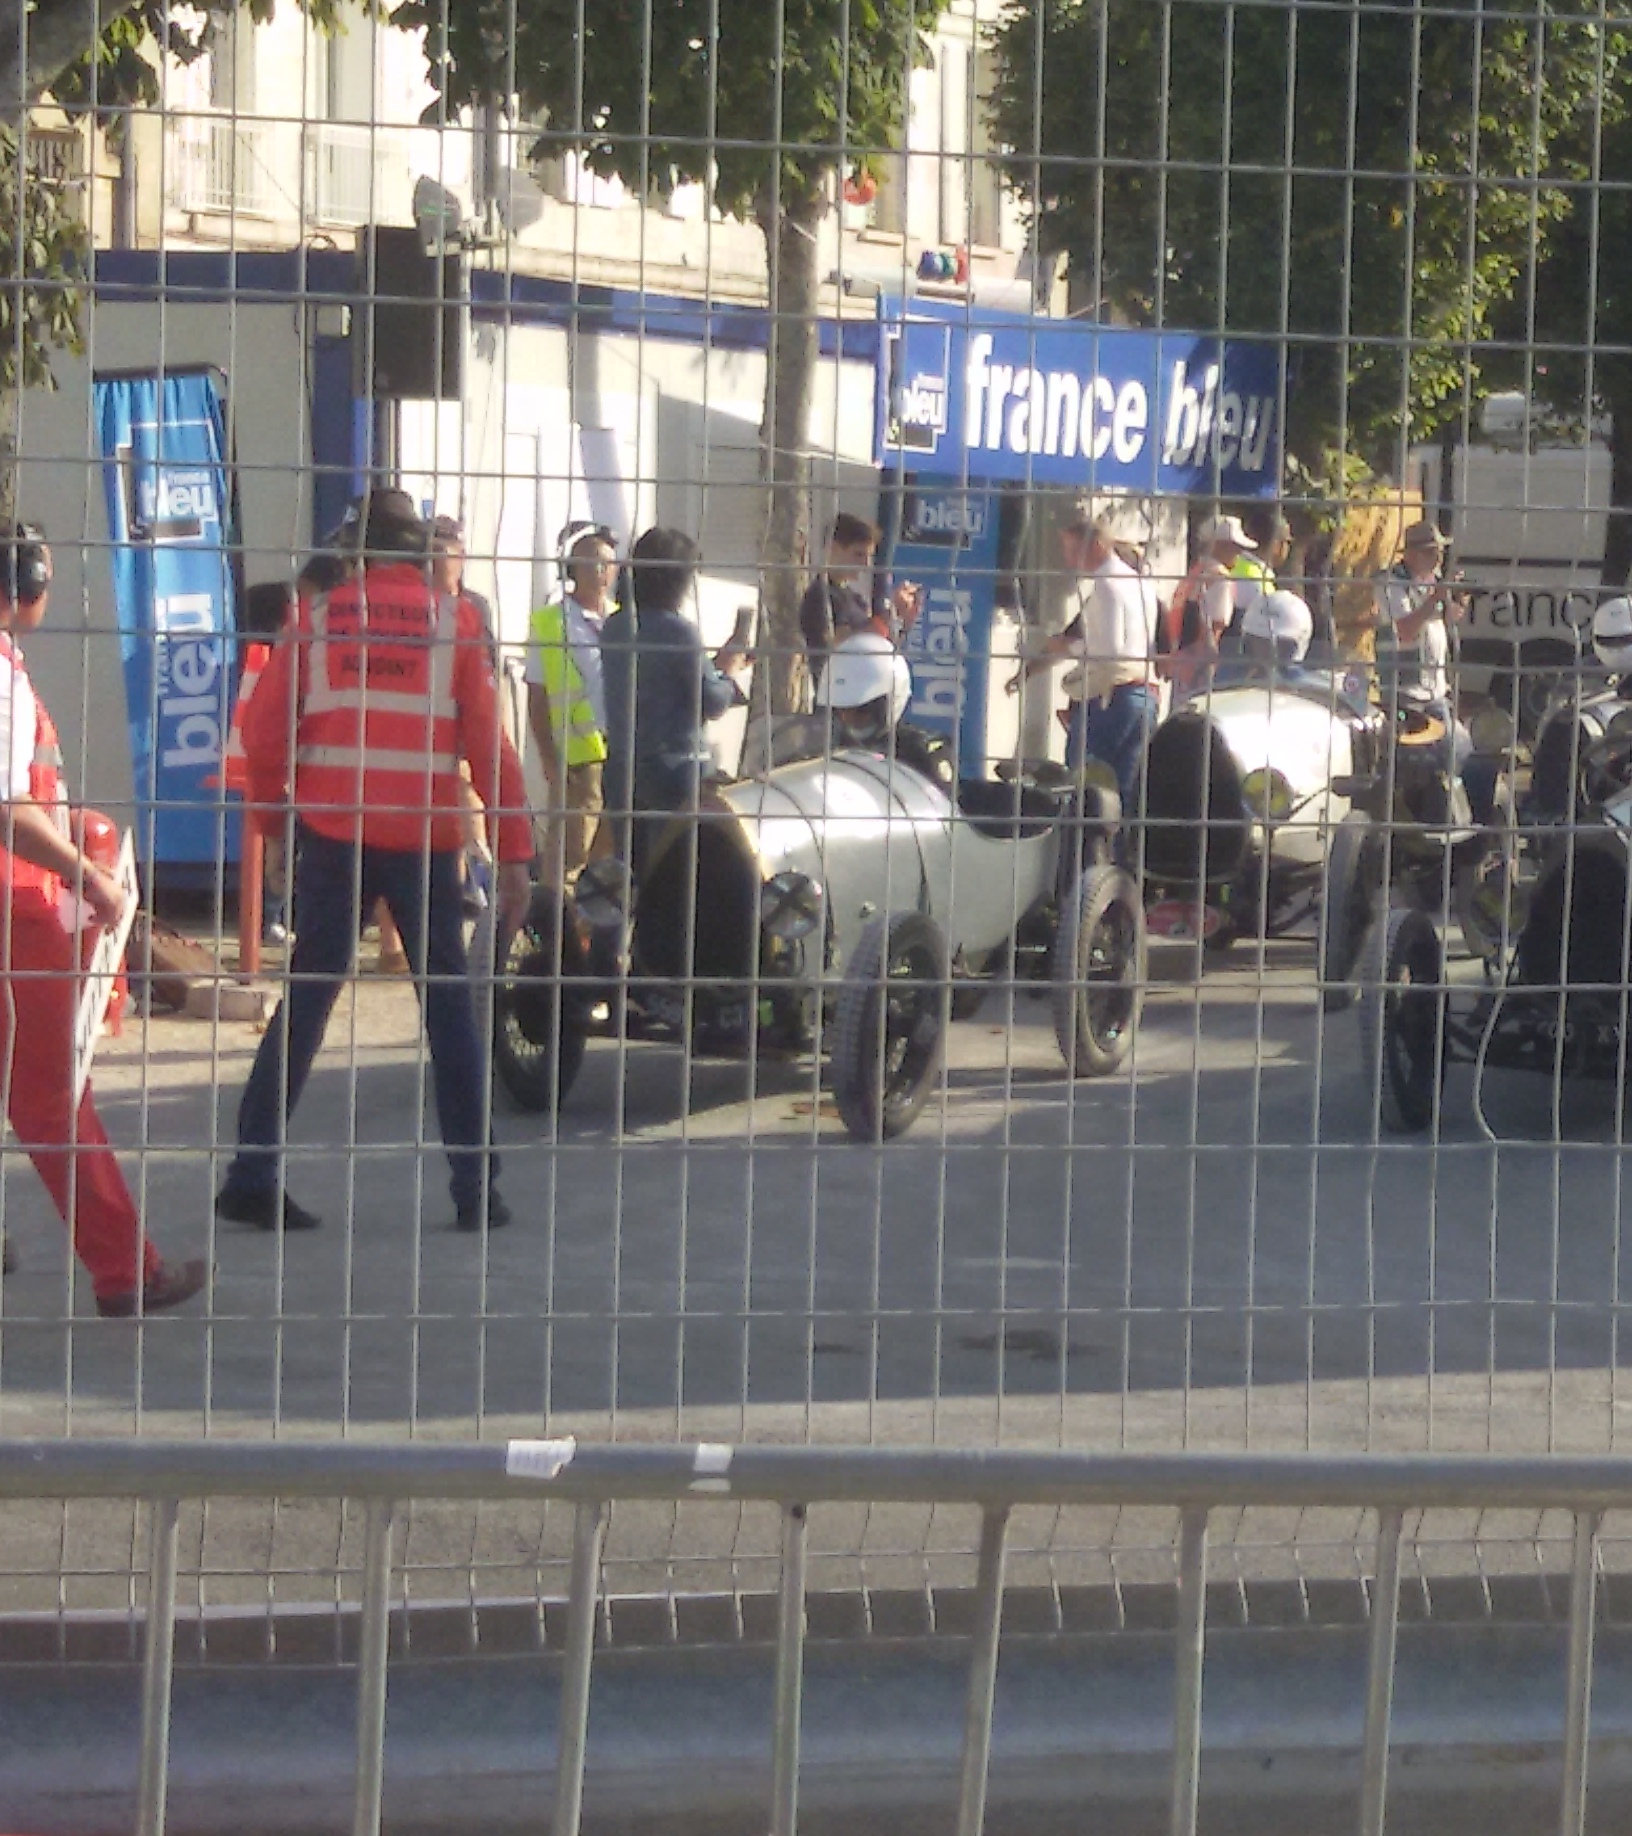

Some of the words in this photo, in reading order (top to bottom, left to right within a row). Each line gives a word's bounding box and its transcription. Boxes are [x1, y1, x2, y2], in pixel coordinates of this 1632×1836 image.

[900, 379, 943, 425] bleu
[965, 332, 1148, 464] france
[1162, 359, 1276, 472] bleu
[140, 474, 215, 517] bleu
[918, 499, 982, 533] bleu
[160, 593, 221, 769] bleu
[911, 588, 972, 718] bleu
